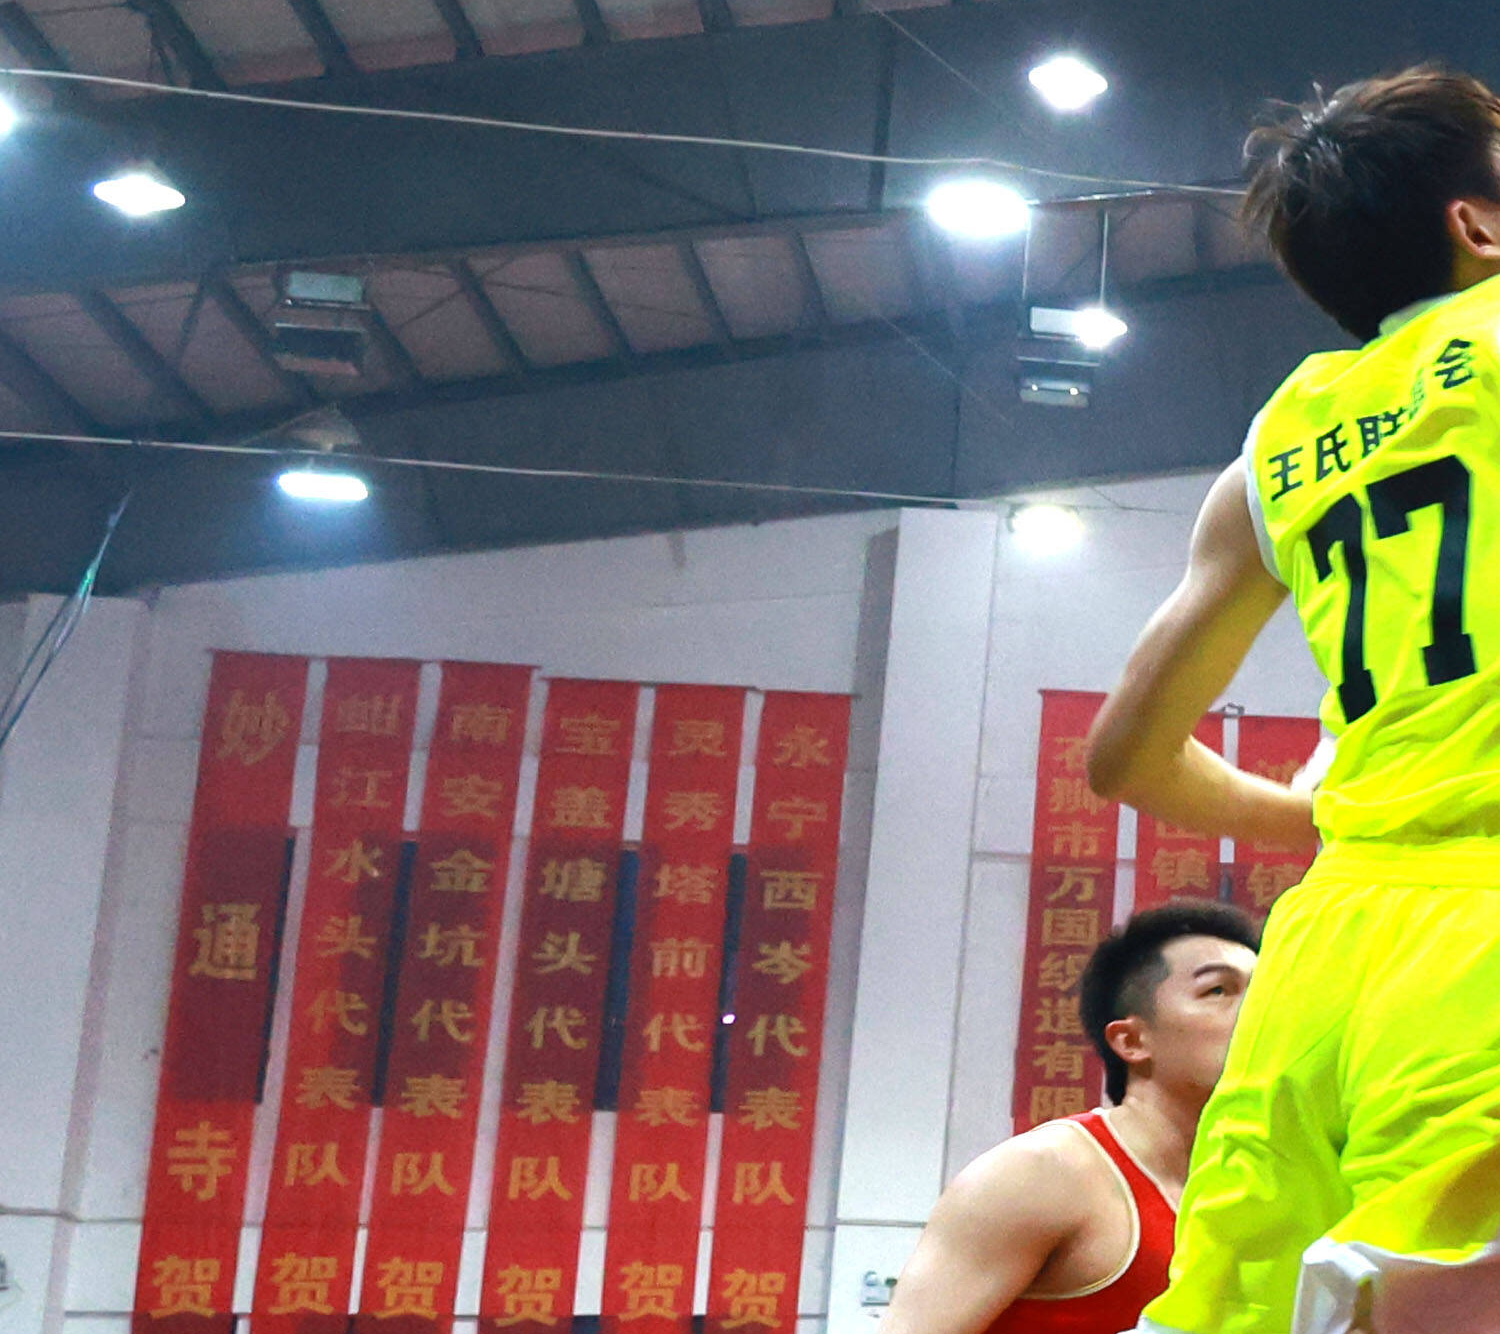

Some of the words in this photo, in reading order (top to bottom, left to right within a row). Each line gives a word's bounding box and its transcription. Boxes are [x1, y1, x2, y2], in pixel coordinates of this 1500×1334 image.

[1268, 339, 1475, 502] 王氏联会
[1307, 455, 1478, 725] 77
[167, 687, 291, 1202] 妙通寺
[391, 701, 513, 1197] 南安金坑代表队
[508, 715, 622, 1203] 宝盖塘头代表队
[629, 719, 728, 1203] 灵秀塔前代表队
[732, 724, 832, 1206] 永宁西岑代表队
[150, 1254, 221, 1319] 贺
[267, 1254, 339, 1316] 贺
[375, 1261, 444, 1319] 贺
[495, 1265, 564, 1326] 贺
[617, 1264, 685, 1322] 贺
[720, 1268, 785, 1329] 贺
